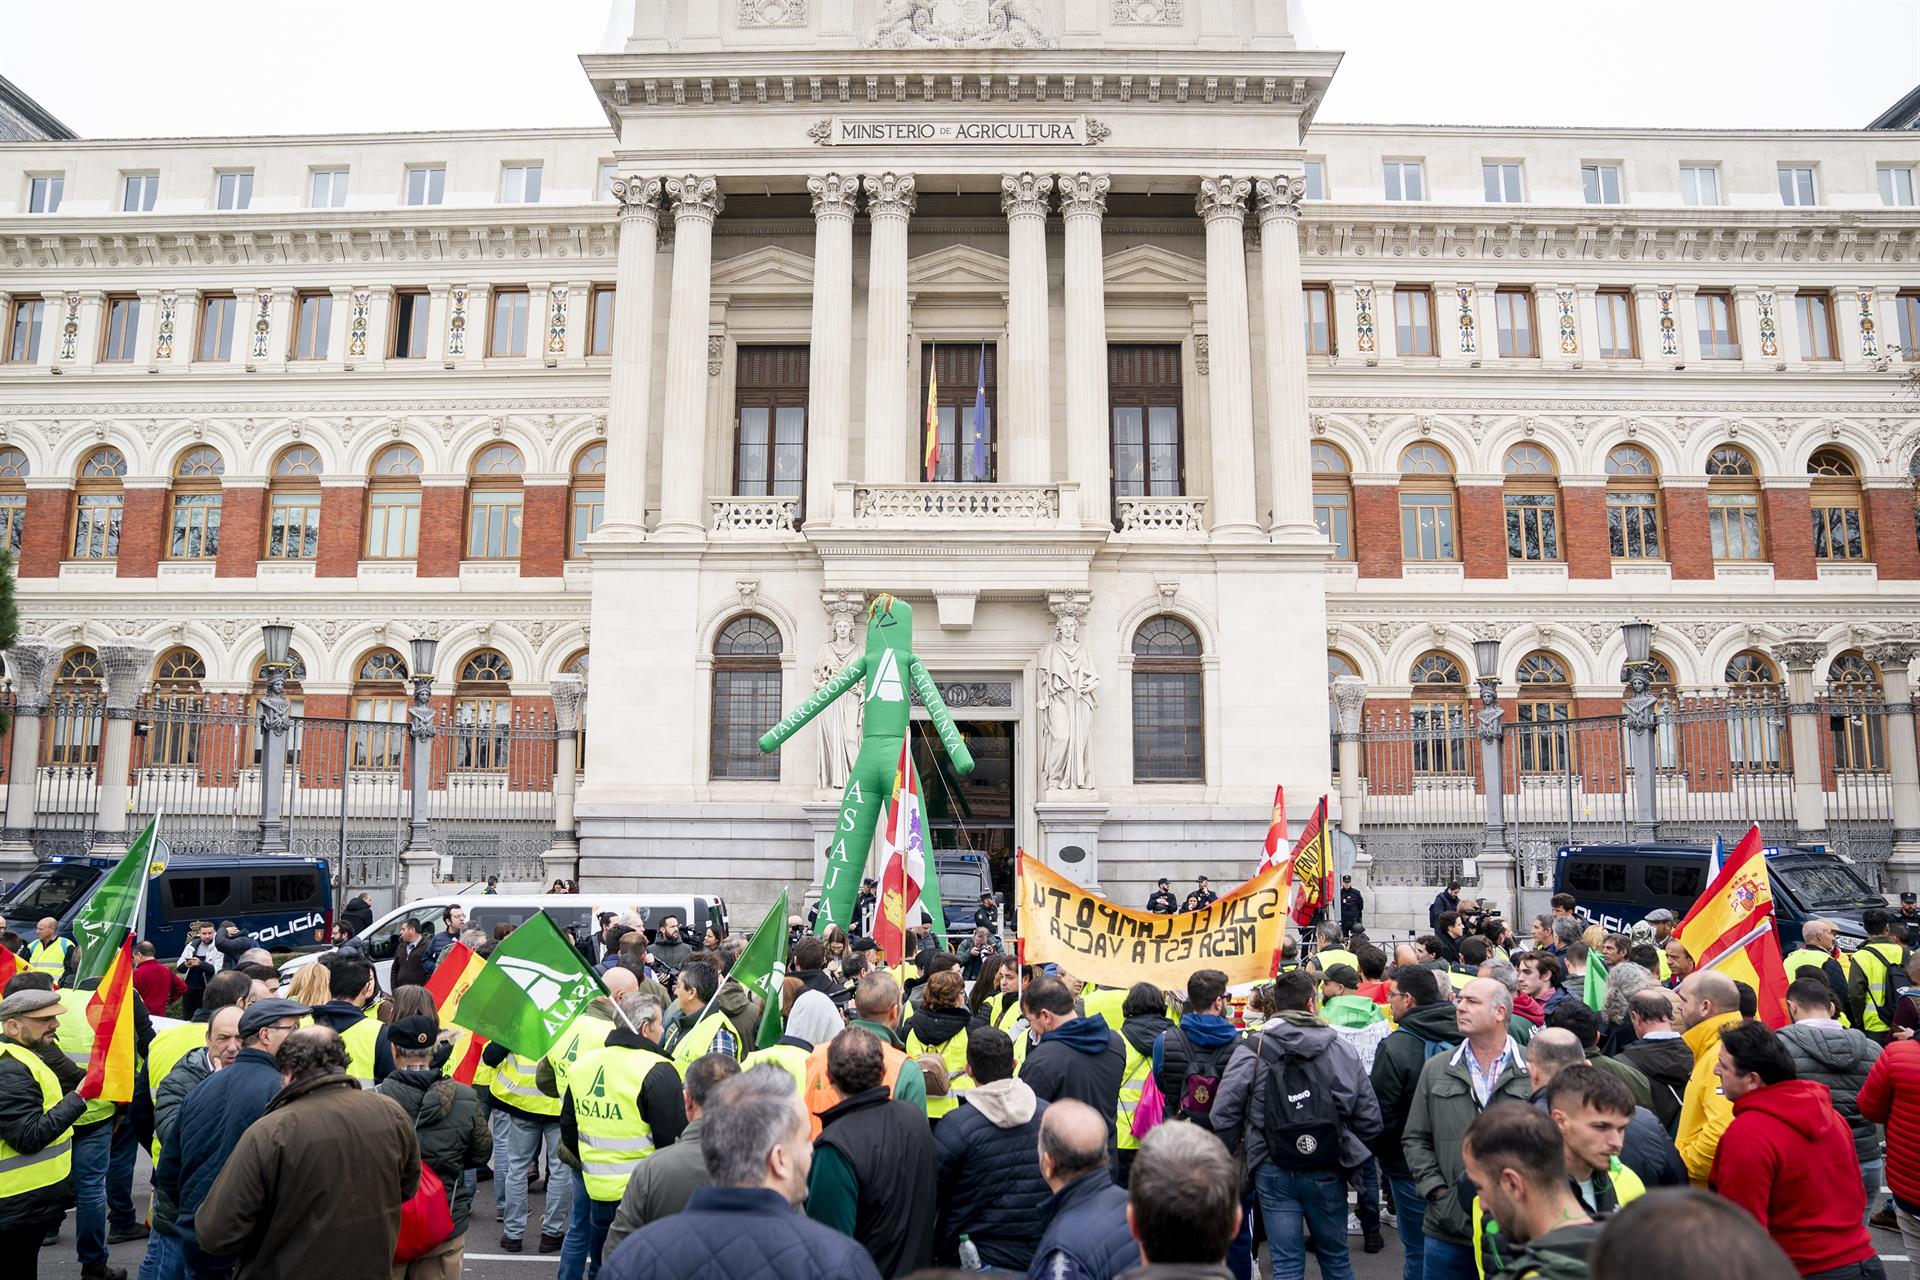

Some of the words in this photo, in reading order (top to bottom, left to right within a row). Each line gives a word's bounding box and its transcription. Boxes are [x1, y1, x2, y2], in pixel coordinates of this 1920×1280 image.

[842, 124, 935, 139] MINISTERIO
[939, 127, 951, 135] DE
[955, 124, 1075, 139] AGRICULTURA
[767, 664, 861, 741] TARRAGONA
[909, 662, 961, 755] CATALUNYA
[817, 779, 864, 922] ASAJA
[575, 1098, 623, 1120] ASAJA
